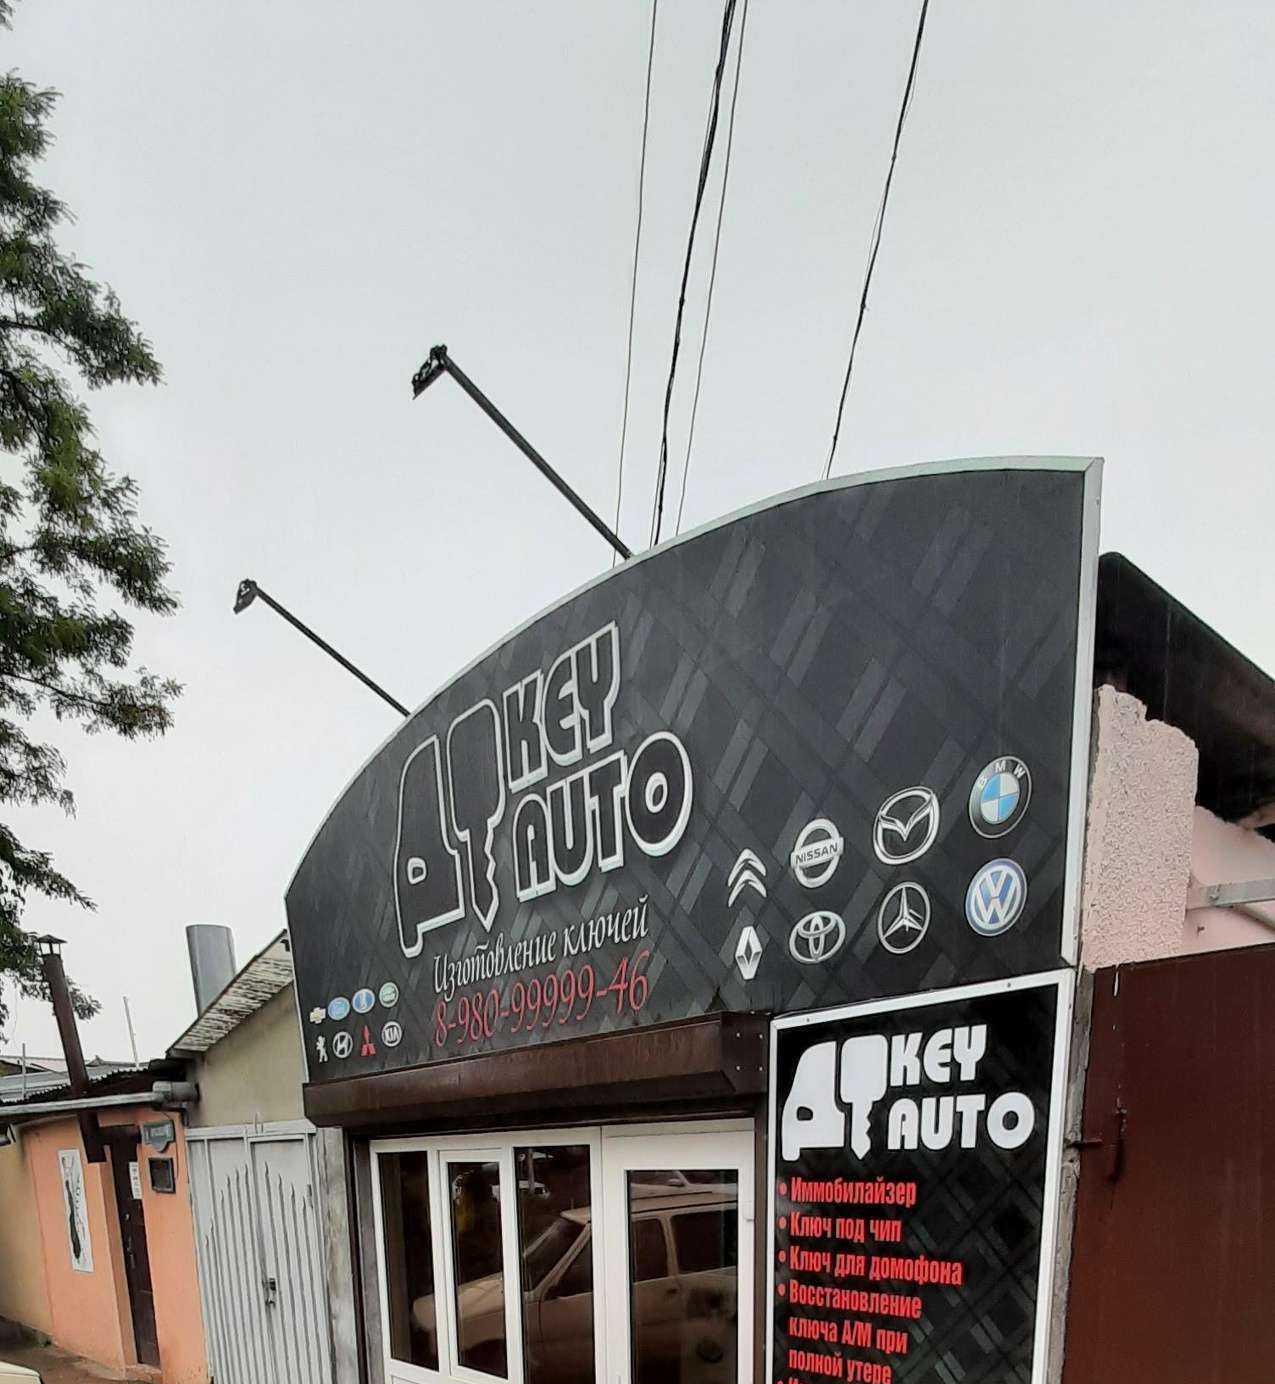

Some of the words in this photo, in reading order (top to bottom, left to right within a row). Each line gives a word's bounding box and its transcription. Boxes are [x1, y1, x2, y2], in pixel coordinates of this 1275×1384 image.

[503, 620, 622, 793] KEY
[513, 731, 693, 902] AUTO
[795, 842, 839, 864] NISSAN
[433, 932, 557, 1003] Изготовление
[563, 894, 649, 958] ключей
[434, 950, 650, 1047] 8-980-99999-46
[890, 1024, 987, 1087] KEY
[888, 1091, 1036, 1150] AUTO
[791, 1176, 917, 1208] Иммобилайзер
[790, 1211, 832, 1238] Ключ
[835, 1218, 865, 1243] под
[869, 1219, 902, 1242] чип
[789, 1245, 831, 1273] Ключ
[834, 1254, 866, 1277] для
[869, 1255, 963, 1286] домофона
[789, 1279, 923, 1319] Восстановление
[789, 1316, 838, 1342] ключа
[841, 1320, 872, 1348] А/М
[876, 1328, 908, 1354] при
[788, 1349, 843, 1378] полной
